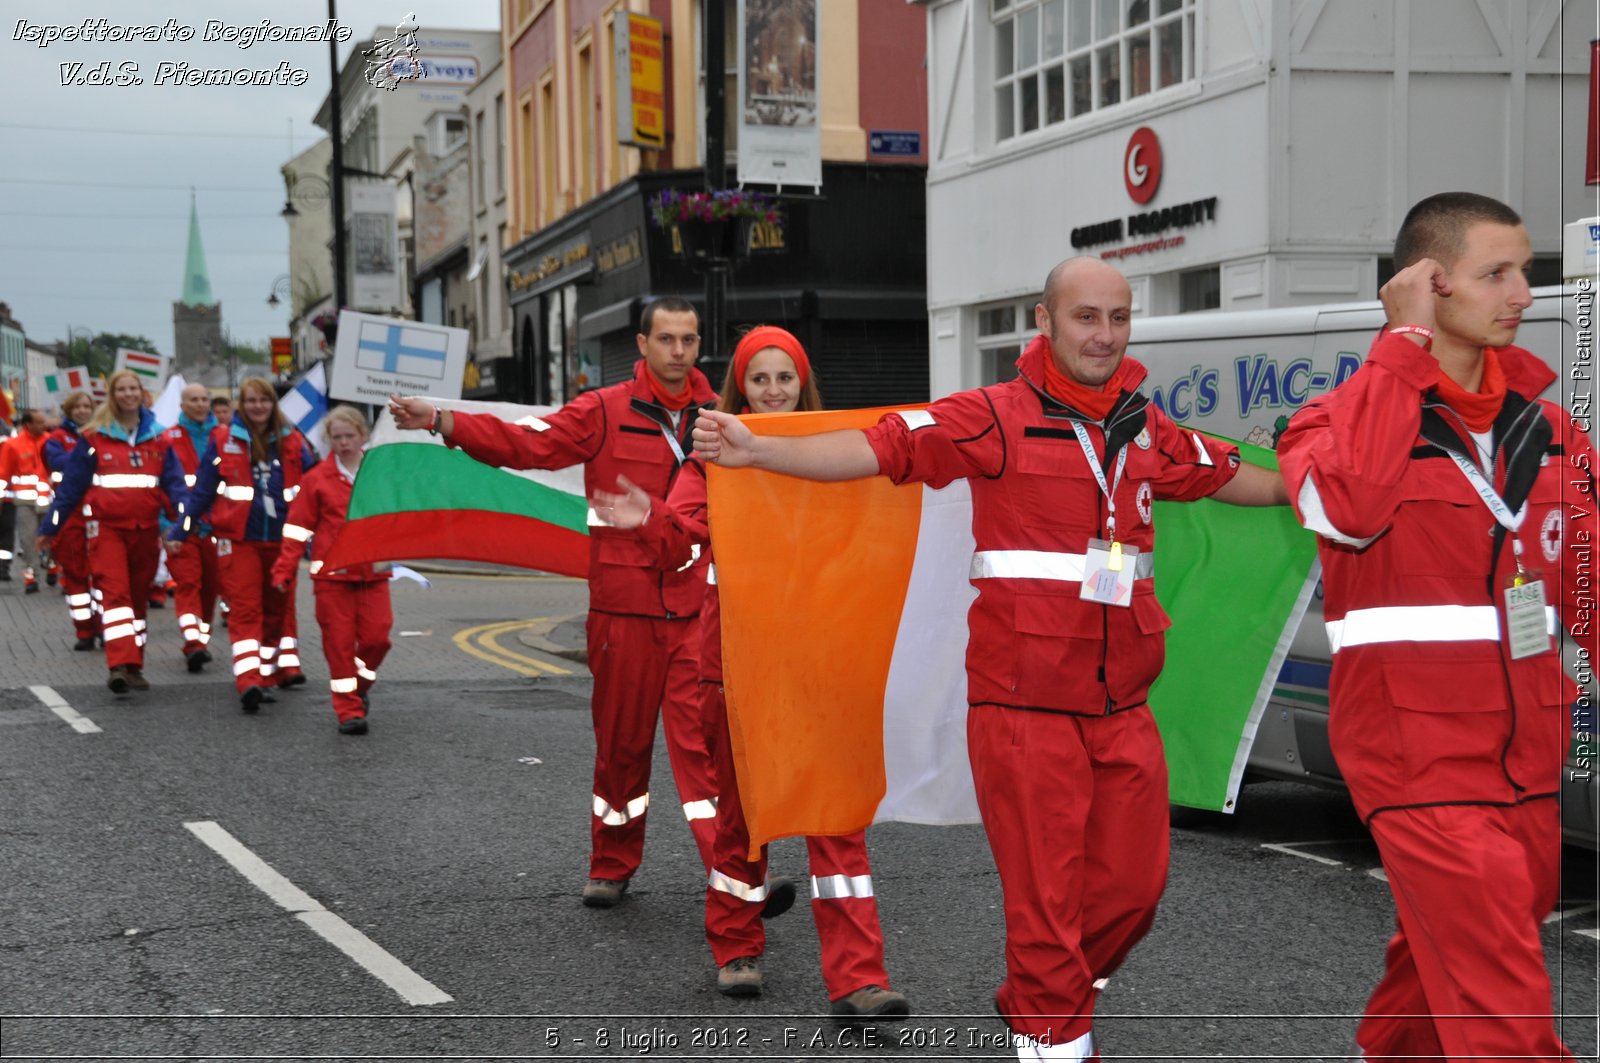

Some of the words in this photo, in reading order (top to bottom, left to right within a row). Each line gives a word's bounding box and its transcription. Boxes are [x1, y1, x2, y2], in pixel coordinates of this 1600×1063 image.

[1128, 197, 1217, 236] PROPERTY
[366, 376, 393, 386] Team
[394, 379, 430, 392] Finland
[1149, 363, 1220, 422] AC'S
